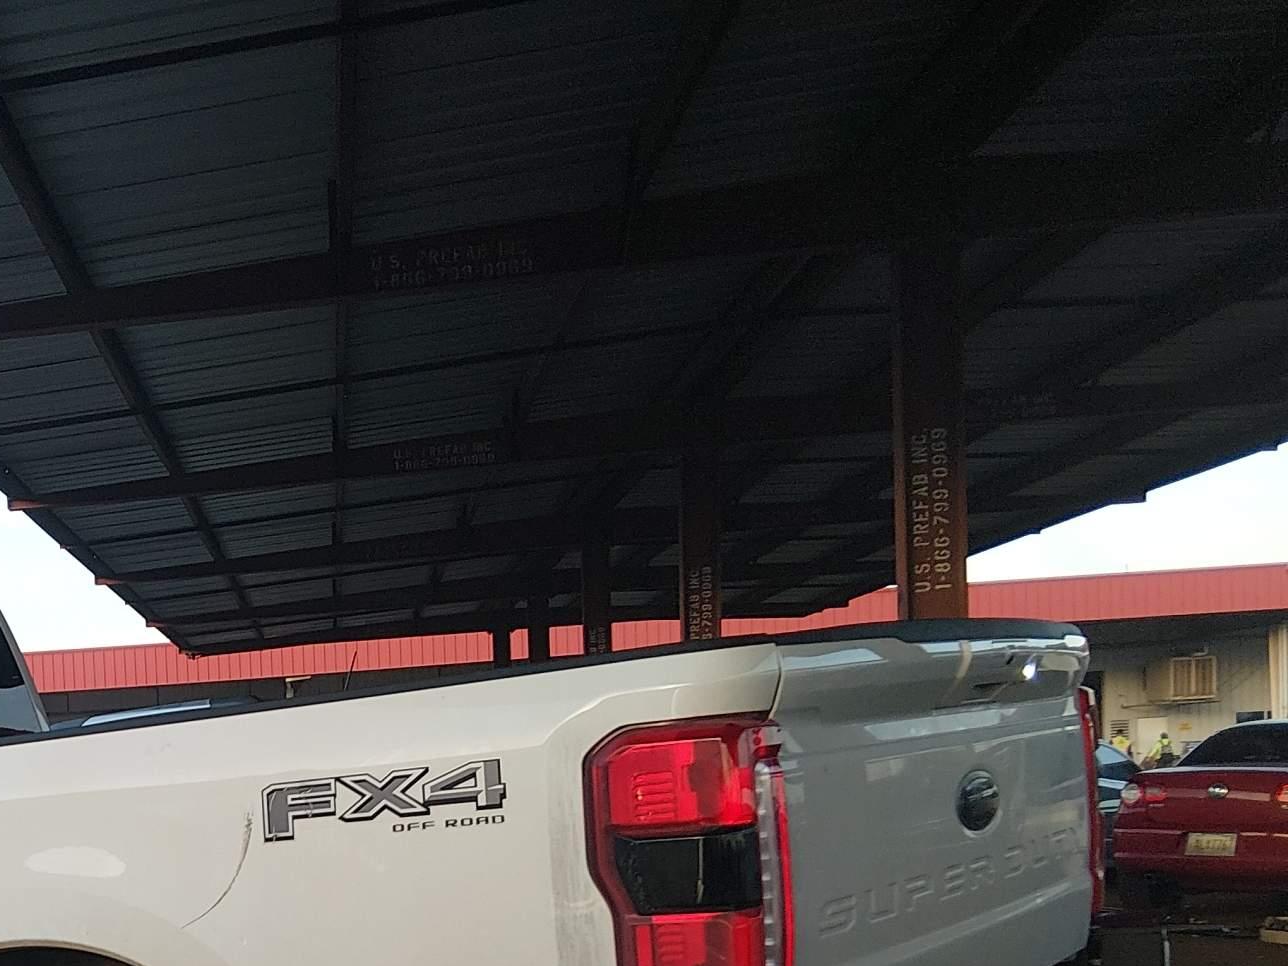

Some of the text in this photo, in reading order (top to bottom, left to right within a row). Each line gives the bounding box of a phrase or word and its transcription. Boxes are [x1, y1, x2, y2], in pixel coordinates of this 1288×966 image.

[911, 428, 931, 592] U.S. PREFAB INC.
[930, 427, 952, 590] 1-866-799-0969
[688, 594, 701, 640] PREFAB
[261, 758, 507, 843] FX4
[392, 814, 507, 833] OFF ROAD
[818, 855, 996, 939] SUPER
